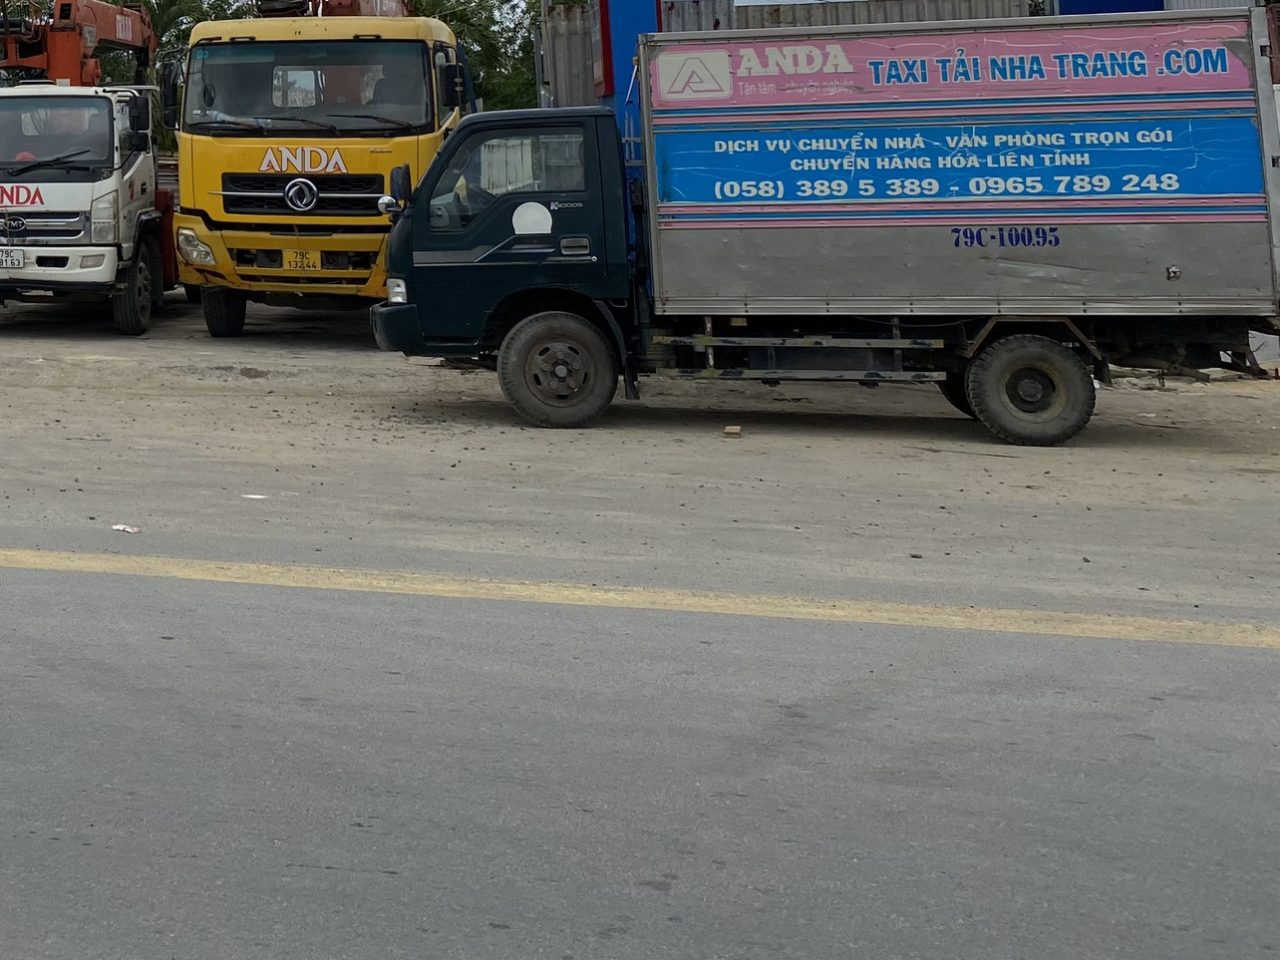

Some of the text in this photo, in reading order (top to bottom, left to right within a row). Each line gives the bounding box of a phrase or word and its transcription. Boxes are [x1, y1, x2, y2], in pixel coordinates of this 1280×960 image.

[736, 44, 853, 77] ANDA
[868, 58, 928, 85] TAXI
[935, 48, 981, 83] TẢI
[989, 54, 1046, 82] NHA
[1053, 49, 1149, 78] TRANG
[714, 140, 760, 155] DỊCH
[765, 139, 791, 154] VỤ
[798, 132, 877, 151] CHUYỂN
[994, 131, 1065, 147] PHÒNG
[1071, 131, 1129, 147] TRỌN
[1136, 127, 1173, 143] GÓI
[258, 147, 349, 173] ANDA
[790, 149, 1090, 171] CHUYỂN HÀNG HÓA LIÊN TỈNH
[714, 181, 784, 199] (058)
[796, 180, 848, 197] 389
[859, 180, 875, 196] 5
[886, 178, 939, 196] 389
[969, 176, 1043, 195] 0965
[1054, 175, 1110, 193] 789
[1122, 173, 1180, 192] 248
[950, 227, 1060, 248] 79C-100.95
[0, 250, 14, 258] 79C
[293, 251, 310, 260] 79C
